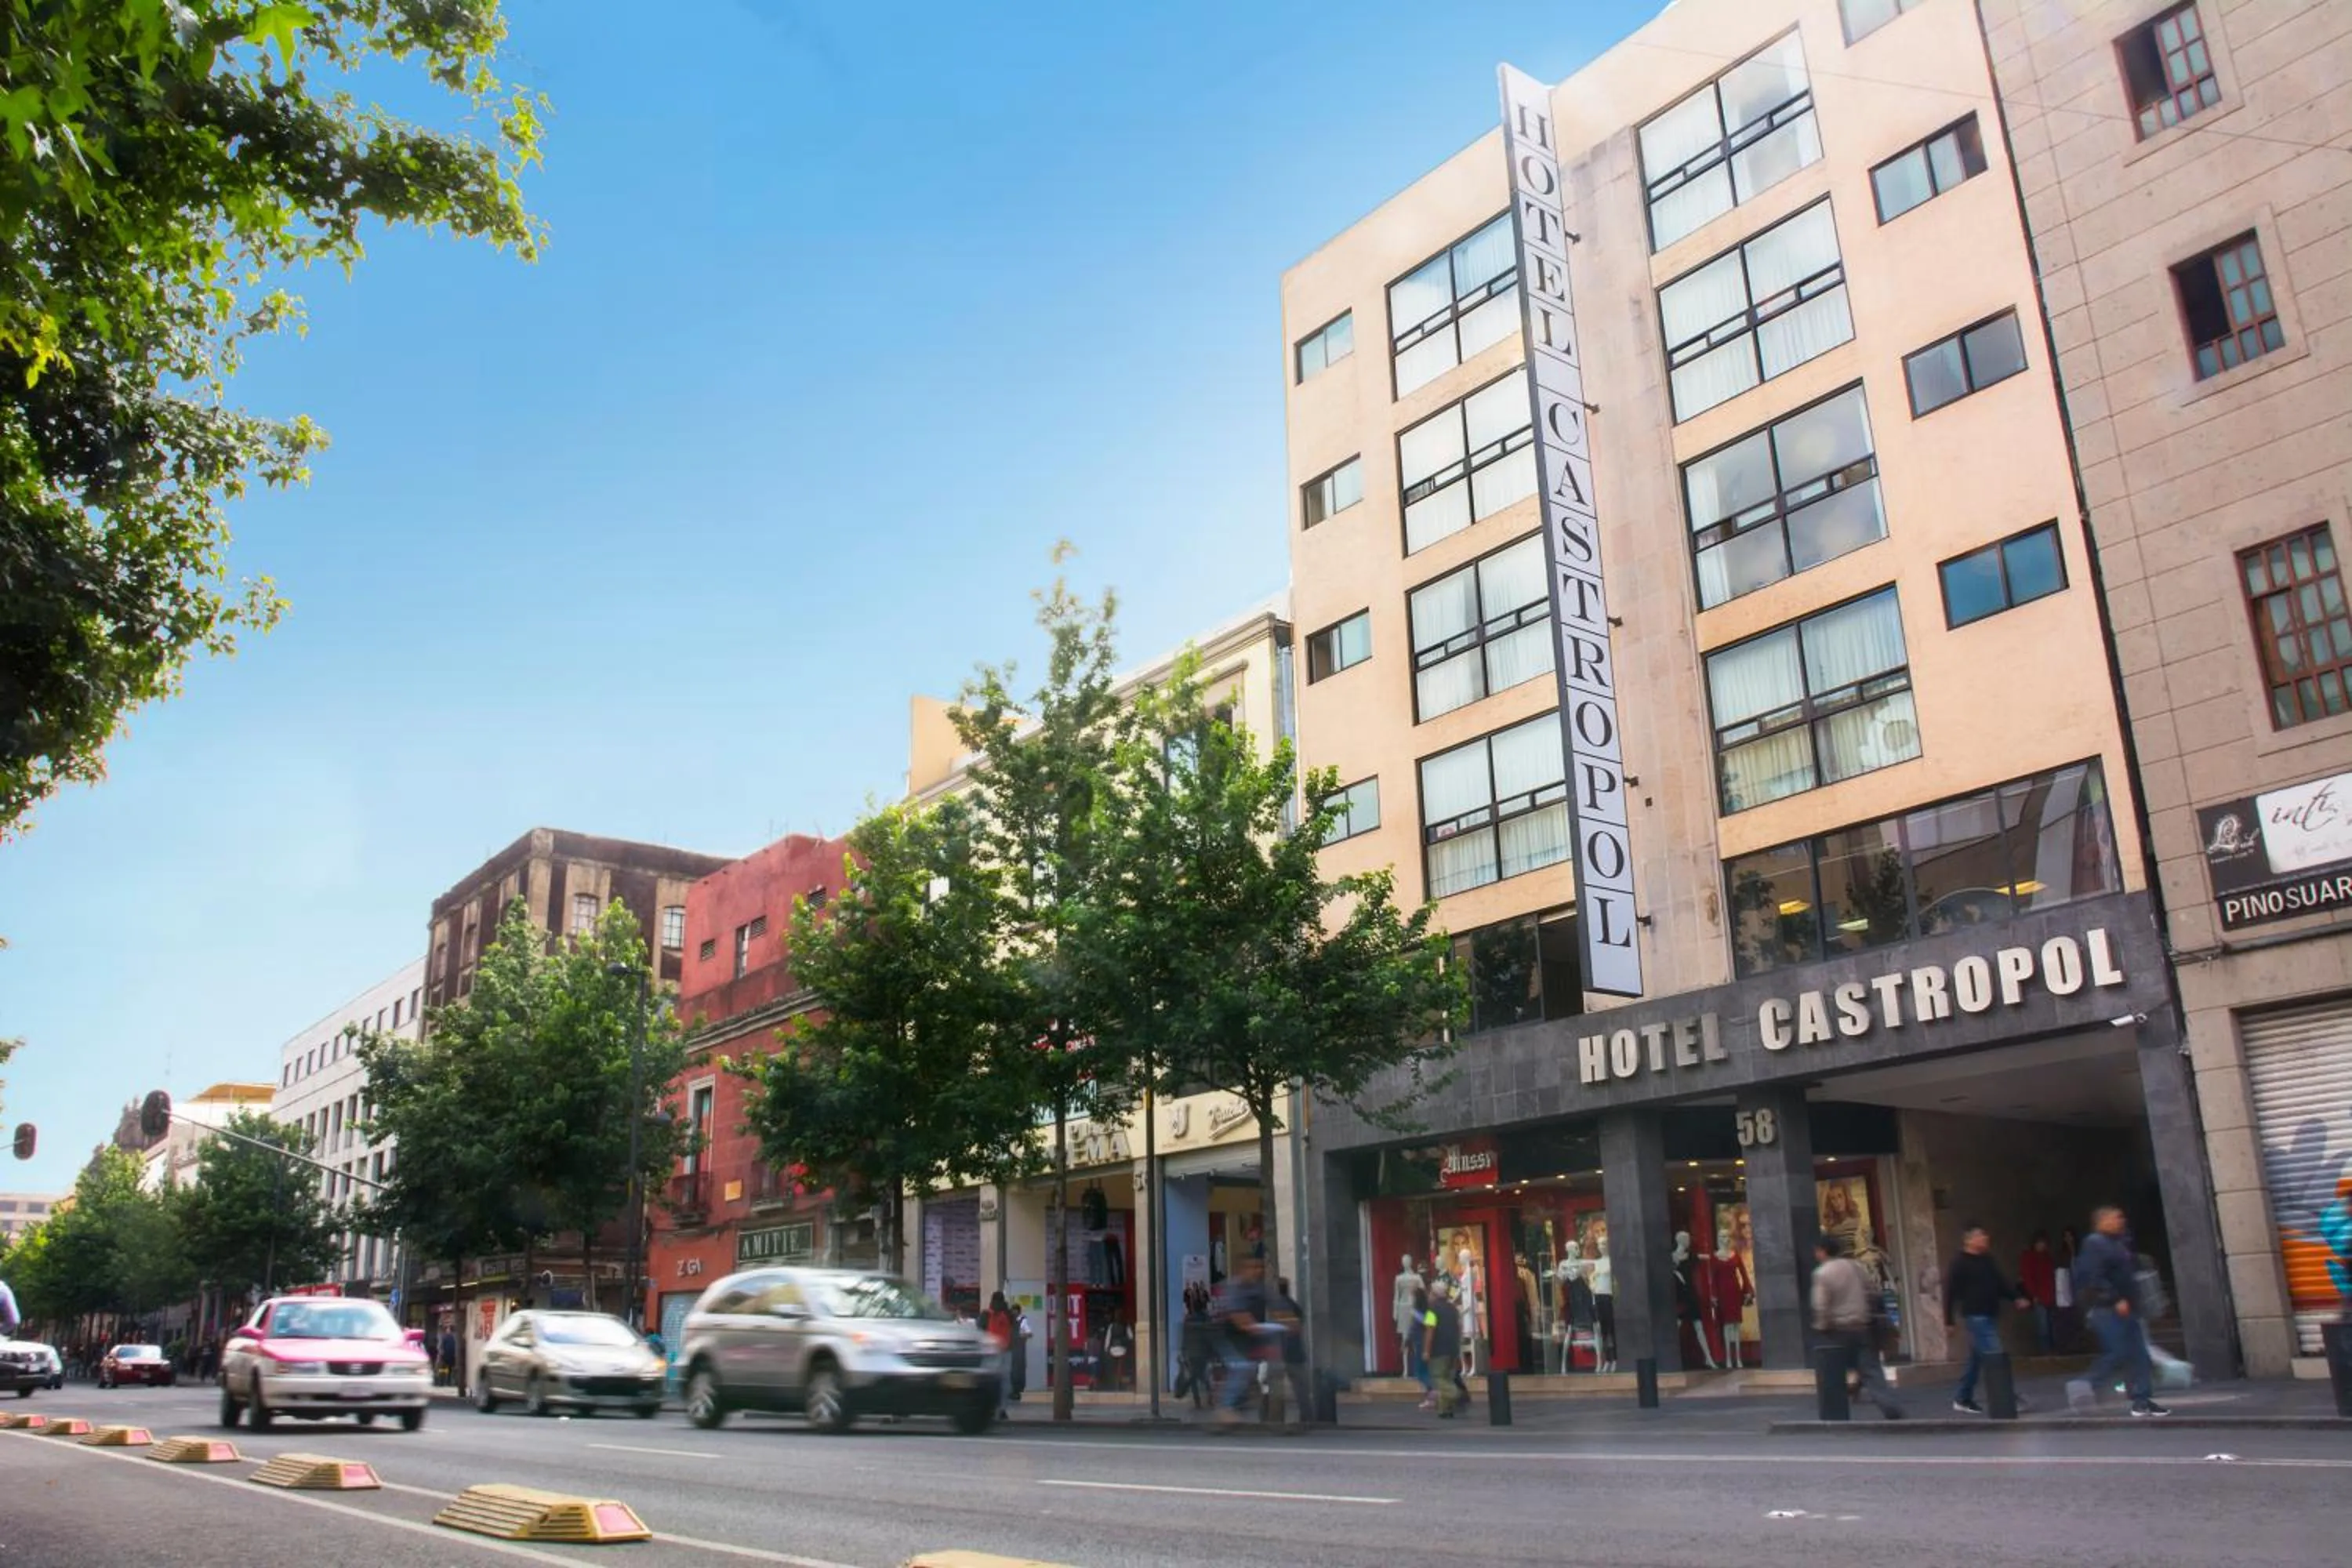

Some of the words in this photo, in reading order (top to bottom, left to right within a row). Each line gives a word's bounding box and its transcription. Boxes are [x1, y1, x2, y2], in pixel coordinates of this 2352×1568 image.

[1516, 103, 1571, 357] HOTEL
[1548, 401, 1632, 949] CASTROPOL
[1578, 1013, 1728, 1084] HOTEL
[1759, 927, 2125, 1051] CASTROPOL
[1735, 1108, 1777, 1148] 58
